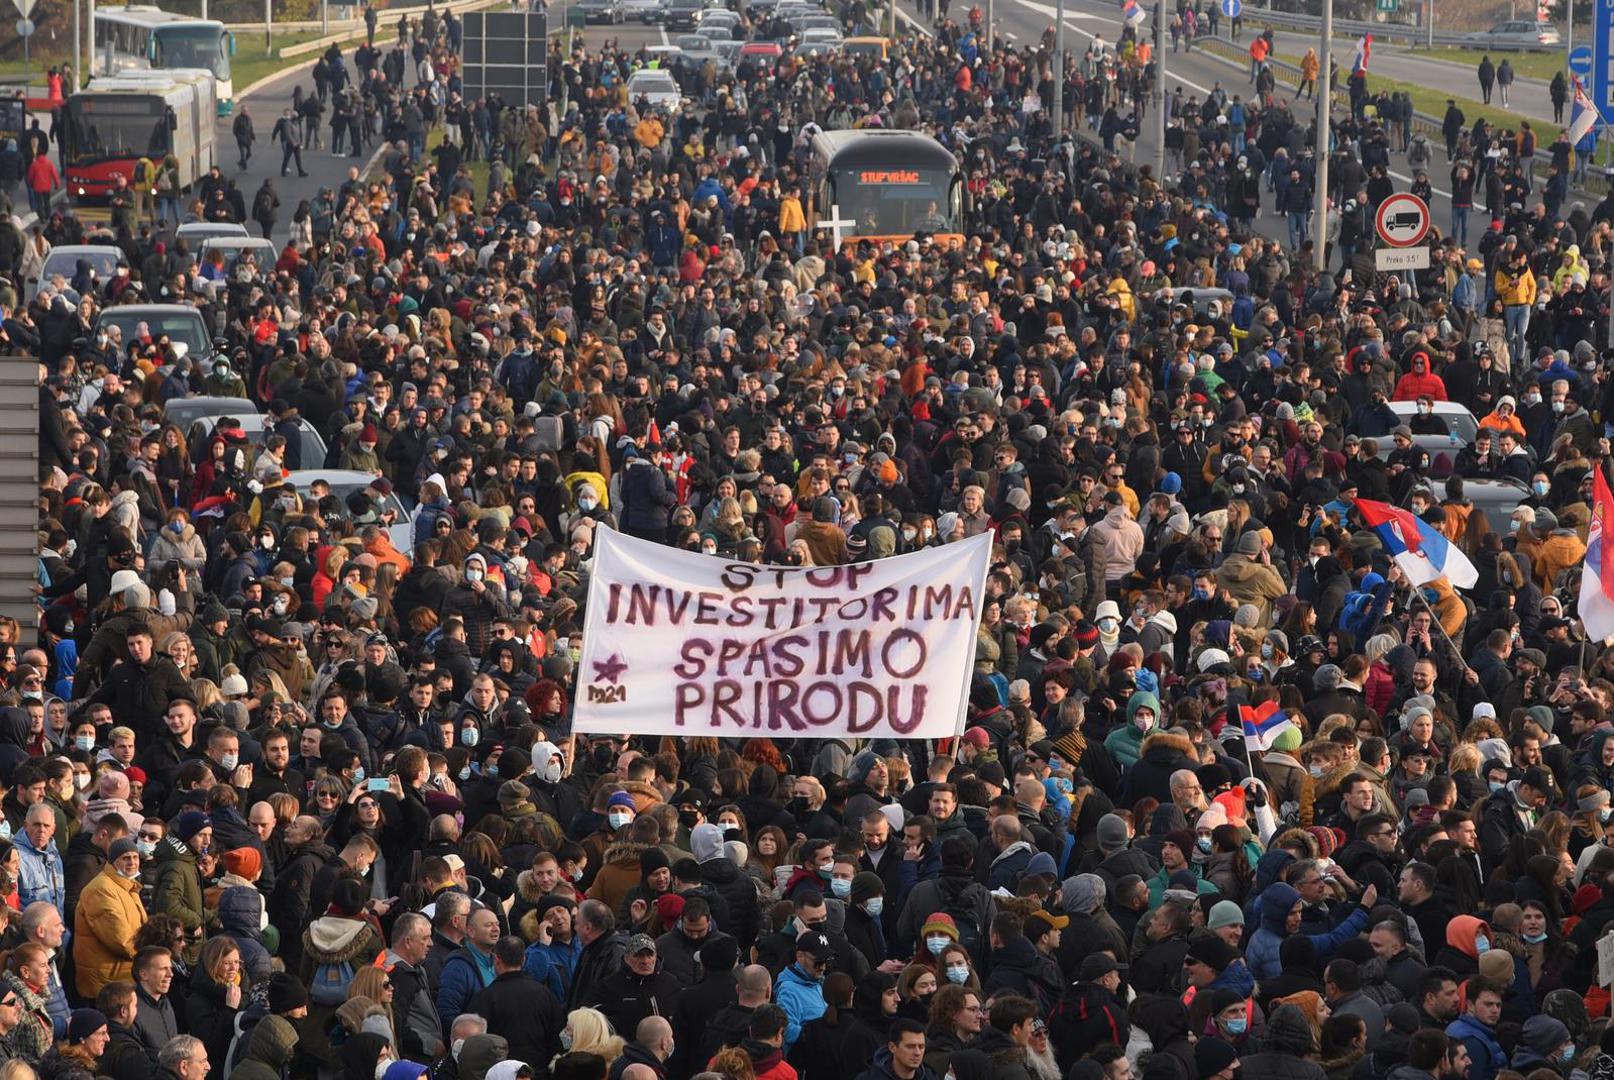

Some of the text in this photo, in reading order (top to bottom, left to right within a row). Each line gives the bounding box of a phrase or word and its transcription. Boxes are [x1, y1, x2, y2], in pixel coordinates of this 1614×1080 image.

[721, 562, 873, 592] STOP
[606, 584, 974, 629] INVESTITORIMA
[674, 629, 927, 679] SPASIMO
[675, 679, 928, 734] PRIRODU
